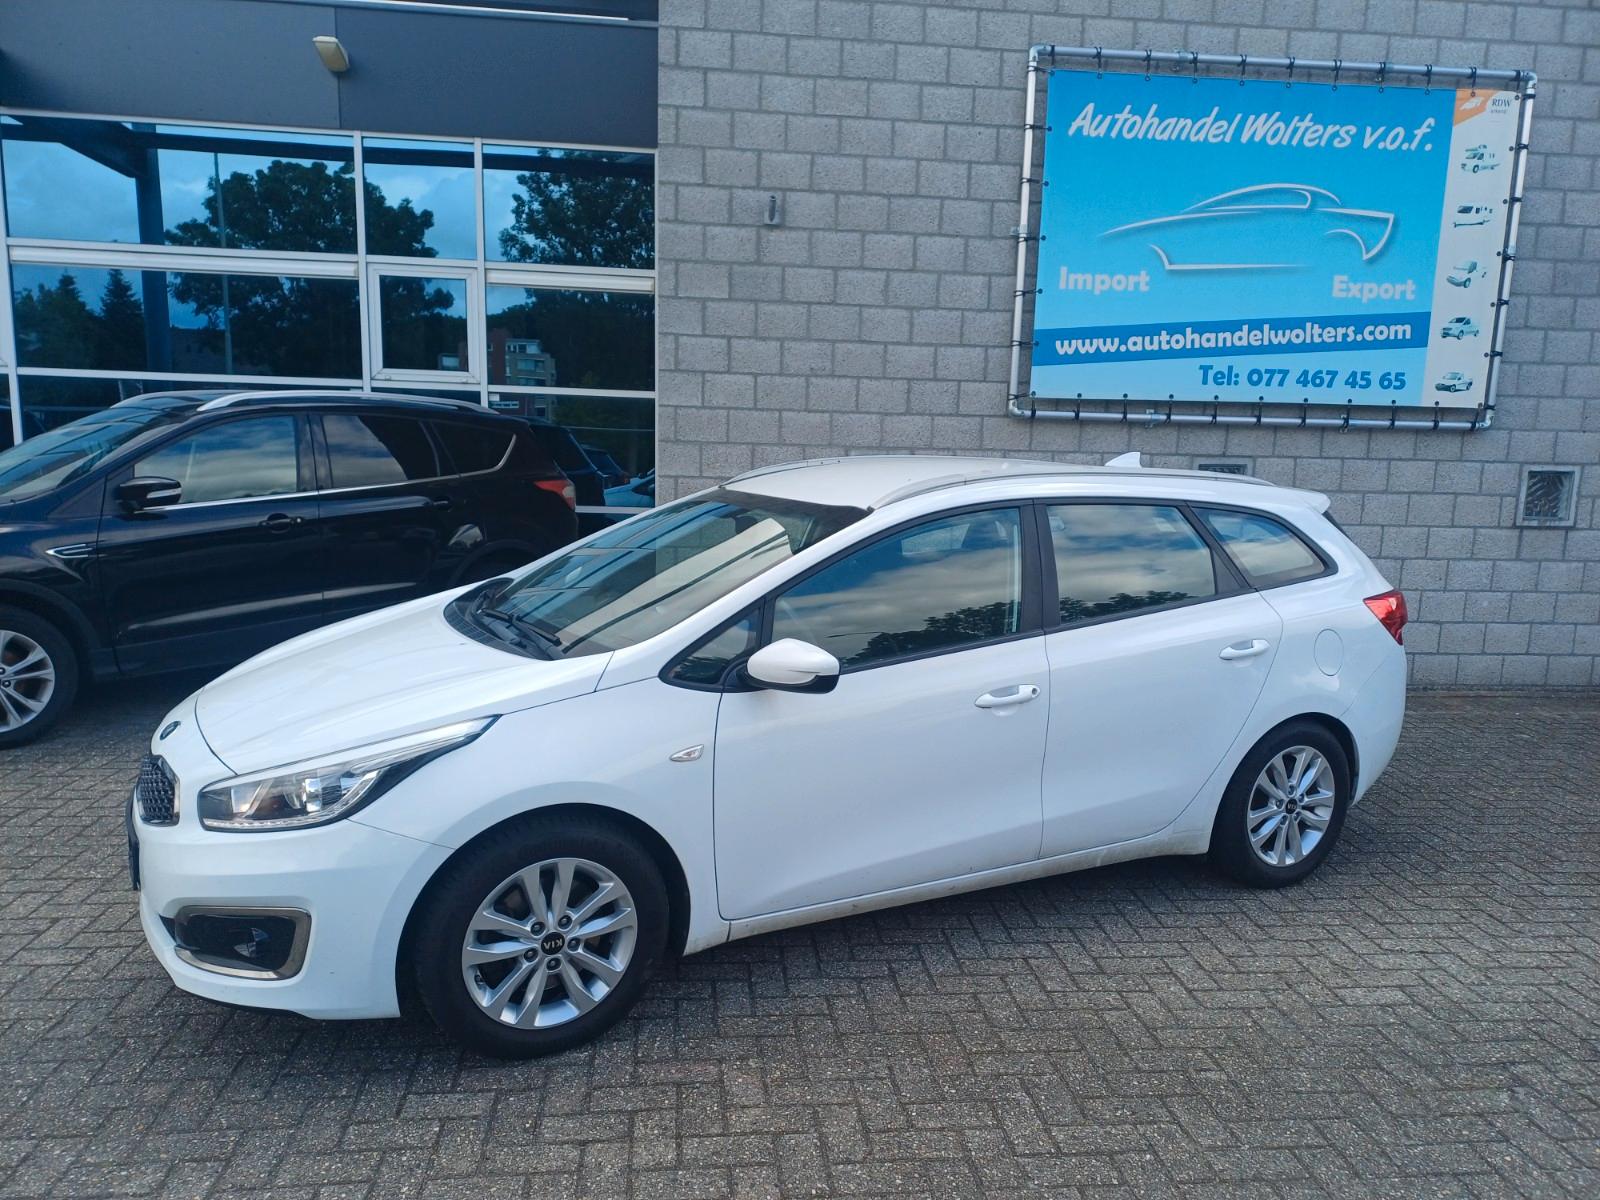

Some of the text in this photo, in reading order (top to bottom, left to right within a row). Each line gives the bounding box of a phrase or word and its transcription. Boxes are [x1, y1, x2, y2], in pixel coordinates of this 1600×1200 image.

[1491, 98, 1512, 108] RDW
[1068, 102, 1435, 151] Autohandel Wolters v.o.f.
[1058, 266, 1150, 295] Import
[1332, 275, 1416, 303] Export
[1055, 321, 1412, 355] www.autohandelwolters.com
[1198, 364, 1407, 390] Tel: 077 467 45 65
[543, 938, 563, 950] KIA
